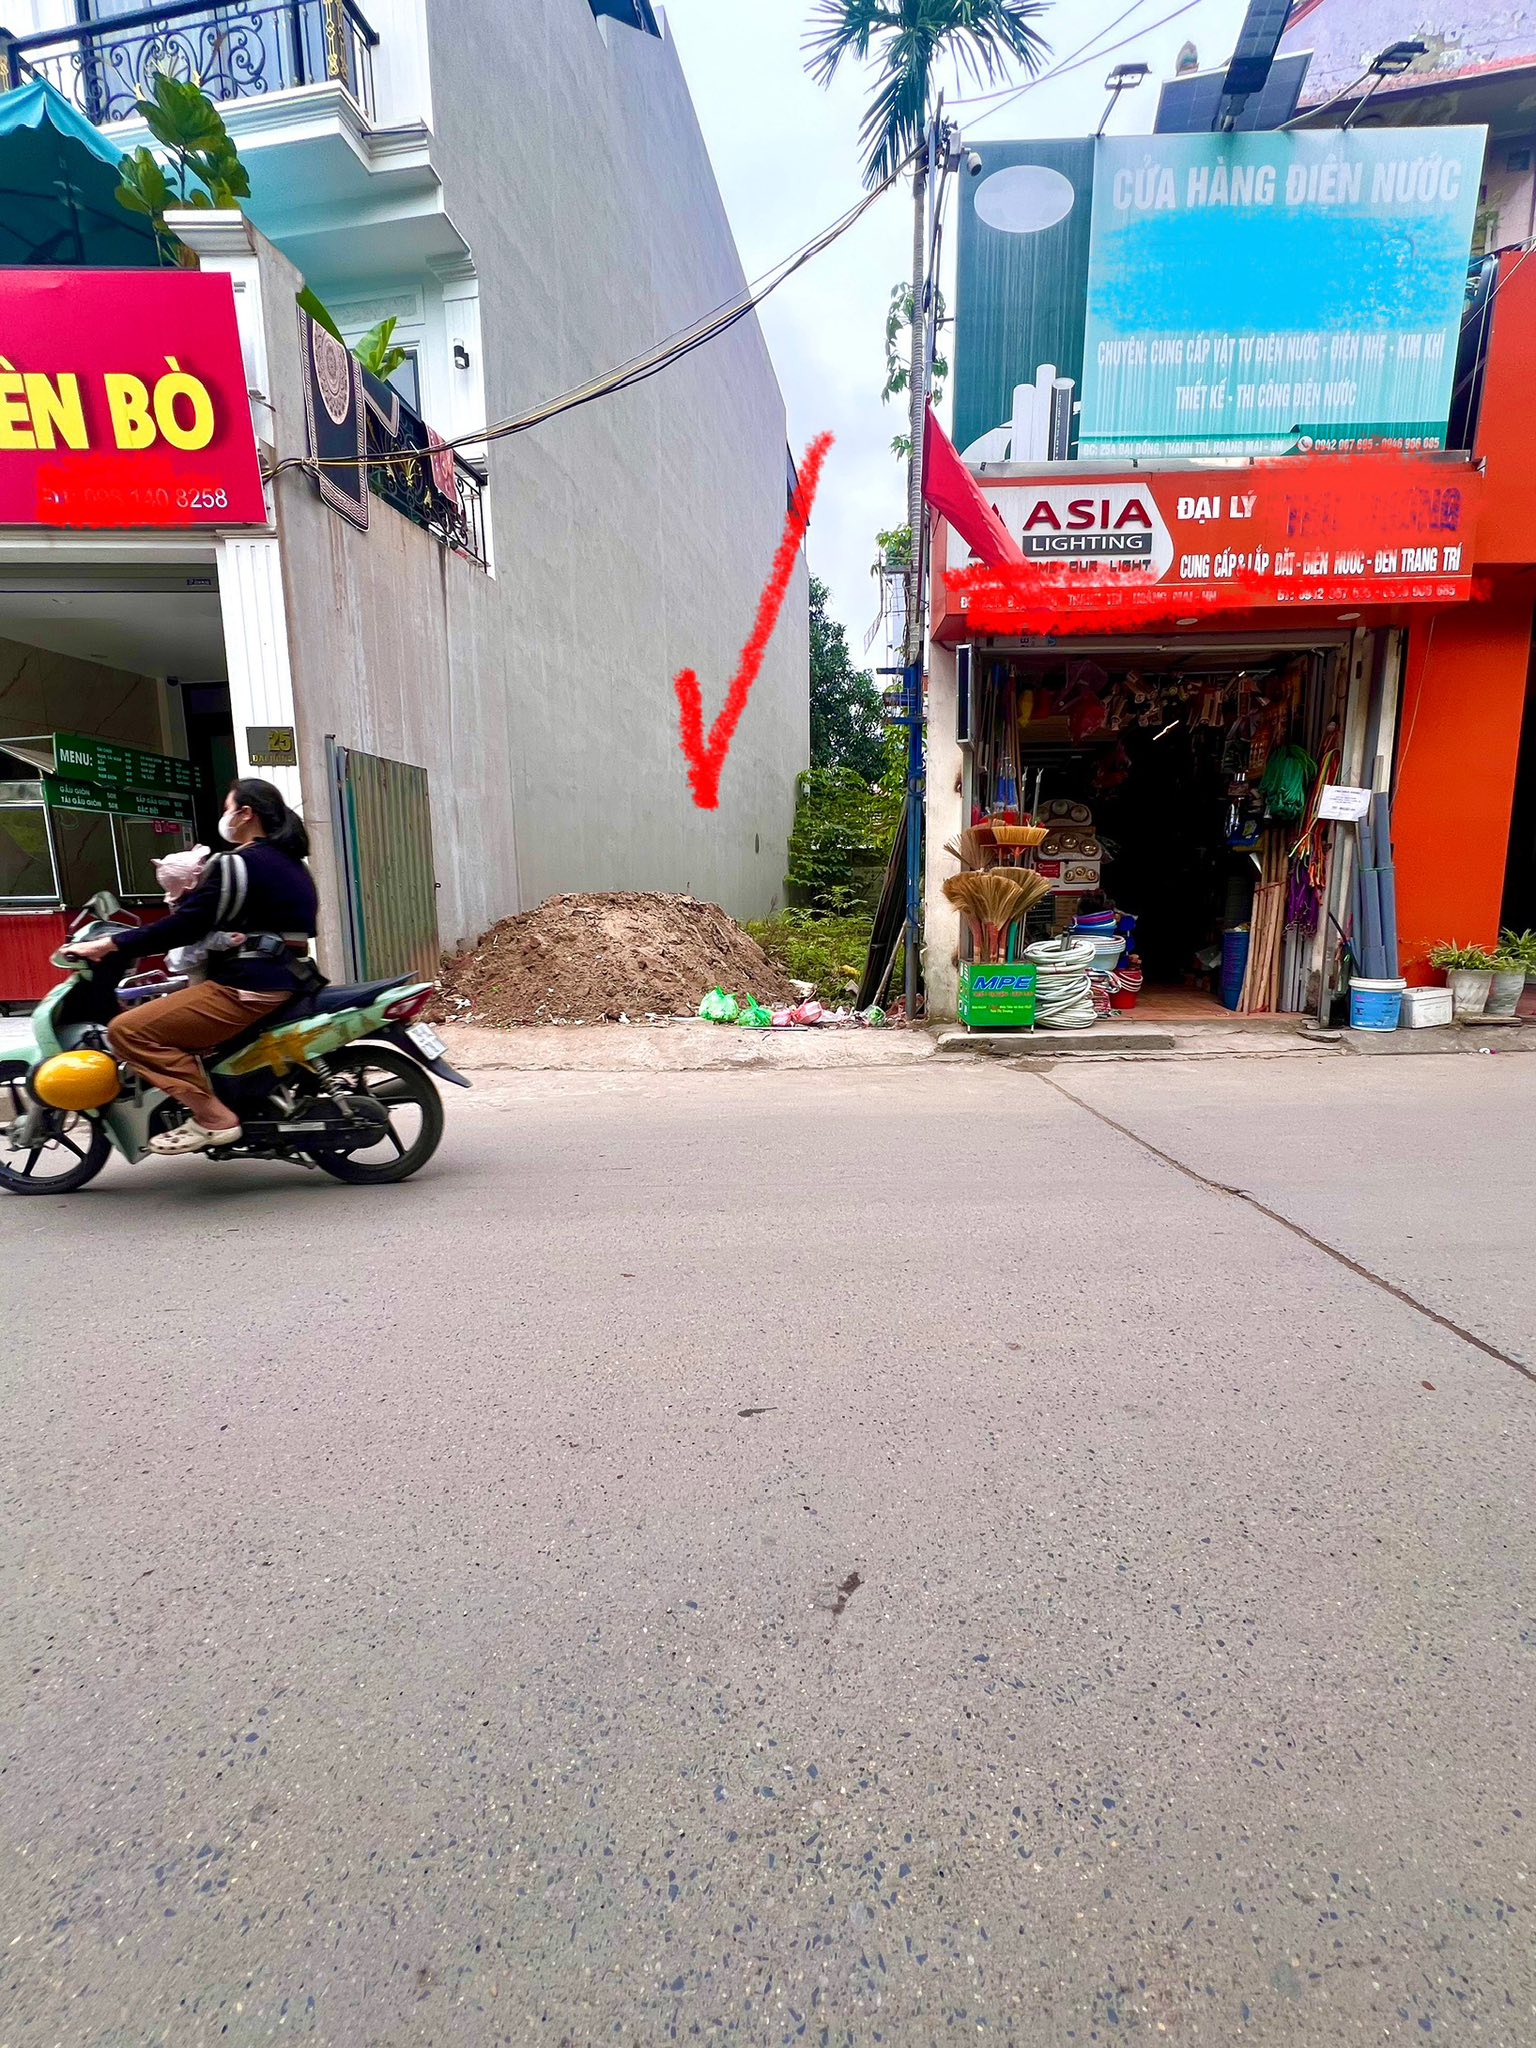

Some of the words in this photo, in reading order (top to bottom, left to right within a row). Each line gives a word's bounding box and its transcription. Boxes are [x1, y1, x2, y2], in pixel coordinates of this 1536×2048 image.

[1112, 154, 1176, 210] CỬA
[1187, 155, 1277, 207] HÀNG
[1371, 151, 1463, 204] NƯỚC
[1151, 338, 1183, 364] CUNG
[1214, 333, 1236, 368] VẬT
[1398, 333, 1422, 359] KIM
[1424, 327, 1446, 358] KHÍ
[104, 355, 215, 451] BÒ
[1237, 383, 1255, 408] THI
[1258, 379, 1290, 408] CÔNG
[1324, 376, 1357, 406] NƯỚC
[175, 487, 228, 509] 8258
[1177, 495, 1221, 524] ĐẠI
[1229, 489, 1258, 519] LÝ
[1023, 499, 1153, 531] ASIA
[1032, 535, 1144, 552] LIGHTING
[1109, 559, 1152, 573] LIGHT
[1180, 554, 1210, 579] CUNG
[1401, 547, 1438, 572] TRANG
[1443, 541, 1463, 571] TRÍ
[268, 730, 292, 752] 25
[59, 748, 93, 767] MENU:
[972, 975, 1033, 990] MPE
